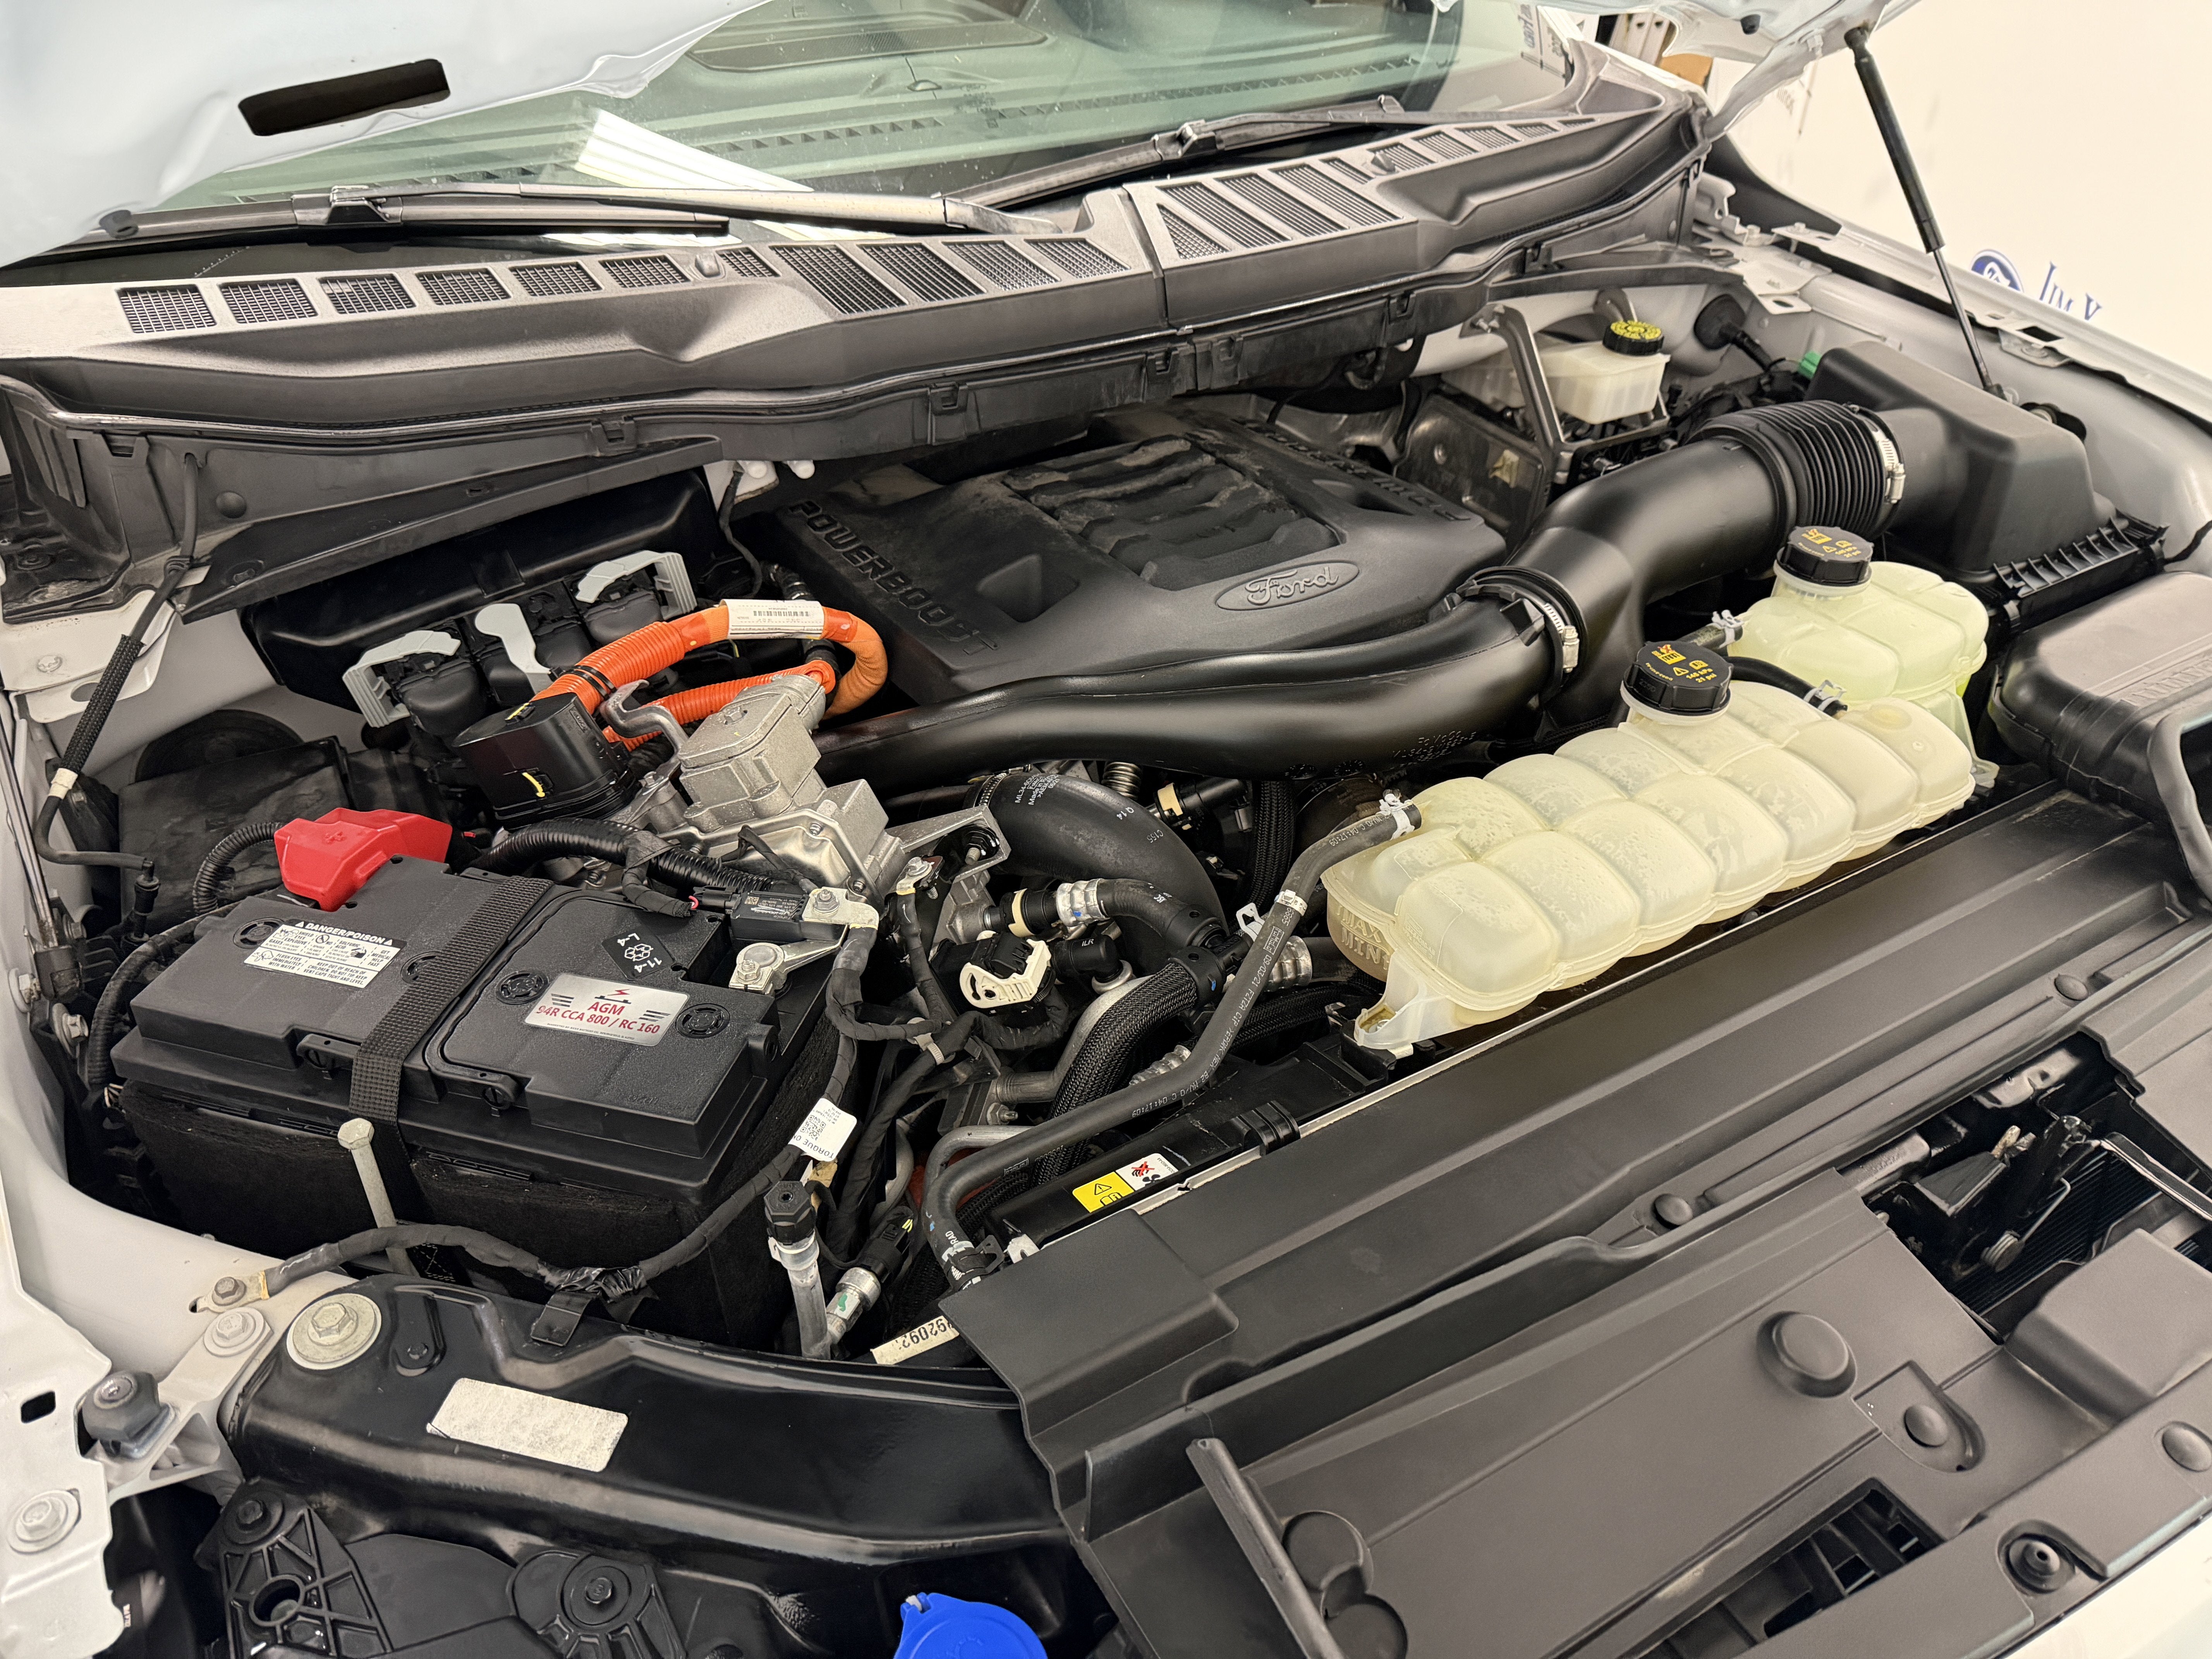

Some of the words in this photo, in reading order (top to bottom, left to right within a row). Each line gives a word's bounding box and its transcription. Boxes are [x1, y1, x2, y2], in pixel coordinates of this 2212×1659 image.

[1245, 567, 1340, 606] Ford
[1028, 788, 1039, 805] Made
[1329, 827, 1358, 846] 04:17:09
[305, 922, 386, 944] DANGER/POISON
[1343, 908, 1381, 943] MAX
[1341, 927, 1382, 964] MIN
[272, 958, 301, 966] IMMEDIATELY
[1251, 954, 1272, 987] 09/03/21
[587, 1001, 625, 1015] AGM
[536, 1005, 560, 1017] 94R
[561, 1010, 585, 1021] CCA
[587, 1014, 610, 1025] 800
[608, 1018, 619, 1027] /
[618, 1019, 637, 1030] RC
[637, 1023, 661, 1034] 160
[1209, 1054, 1221, 1070] MEX
[1132, 1096, 1168, 1118] 04:17:09
[802, 1139, 834, 1159] TORQUE
[945, 1230, 958, 1245] RAD
